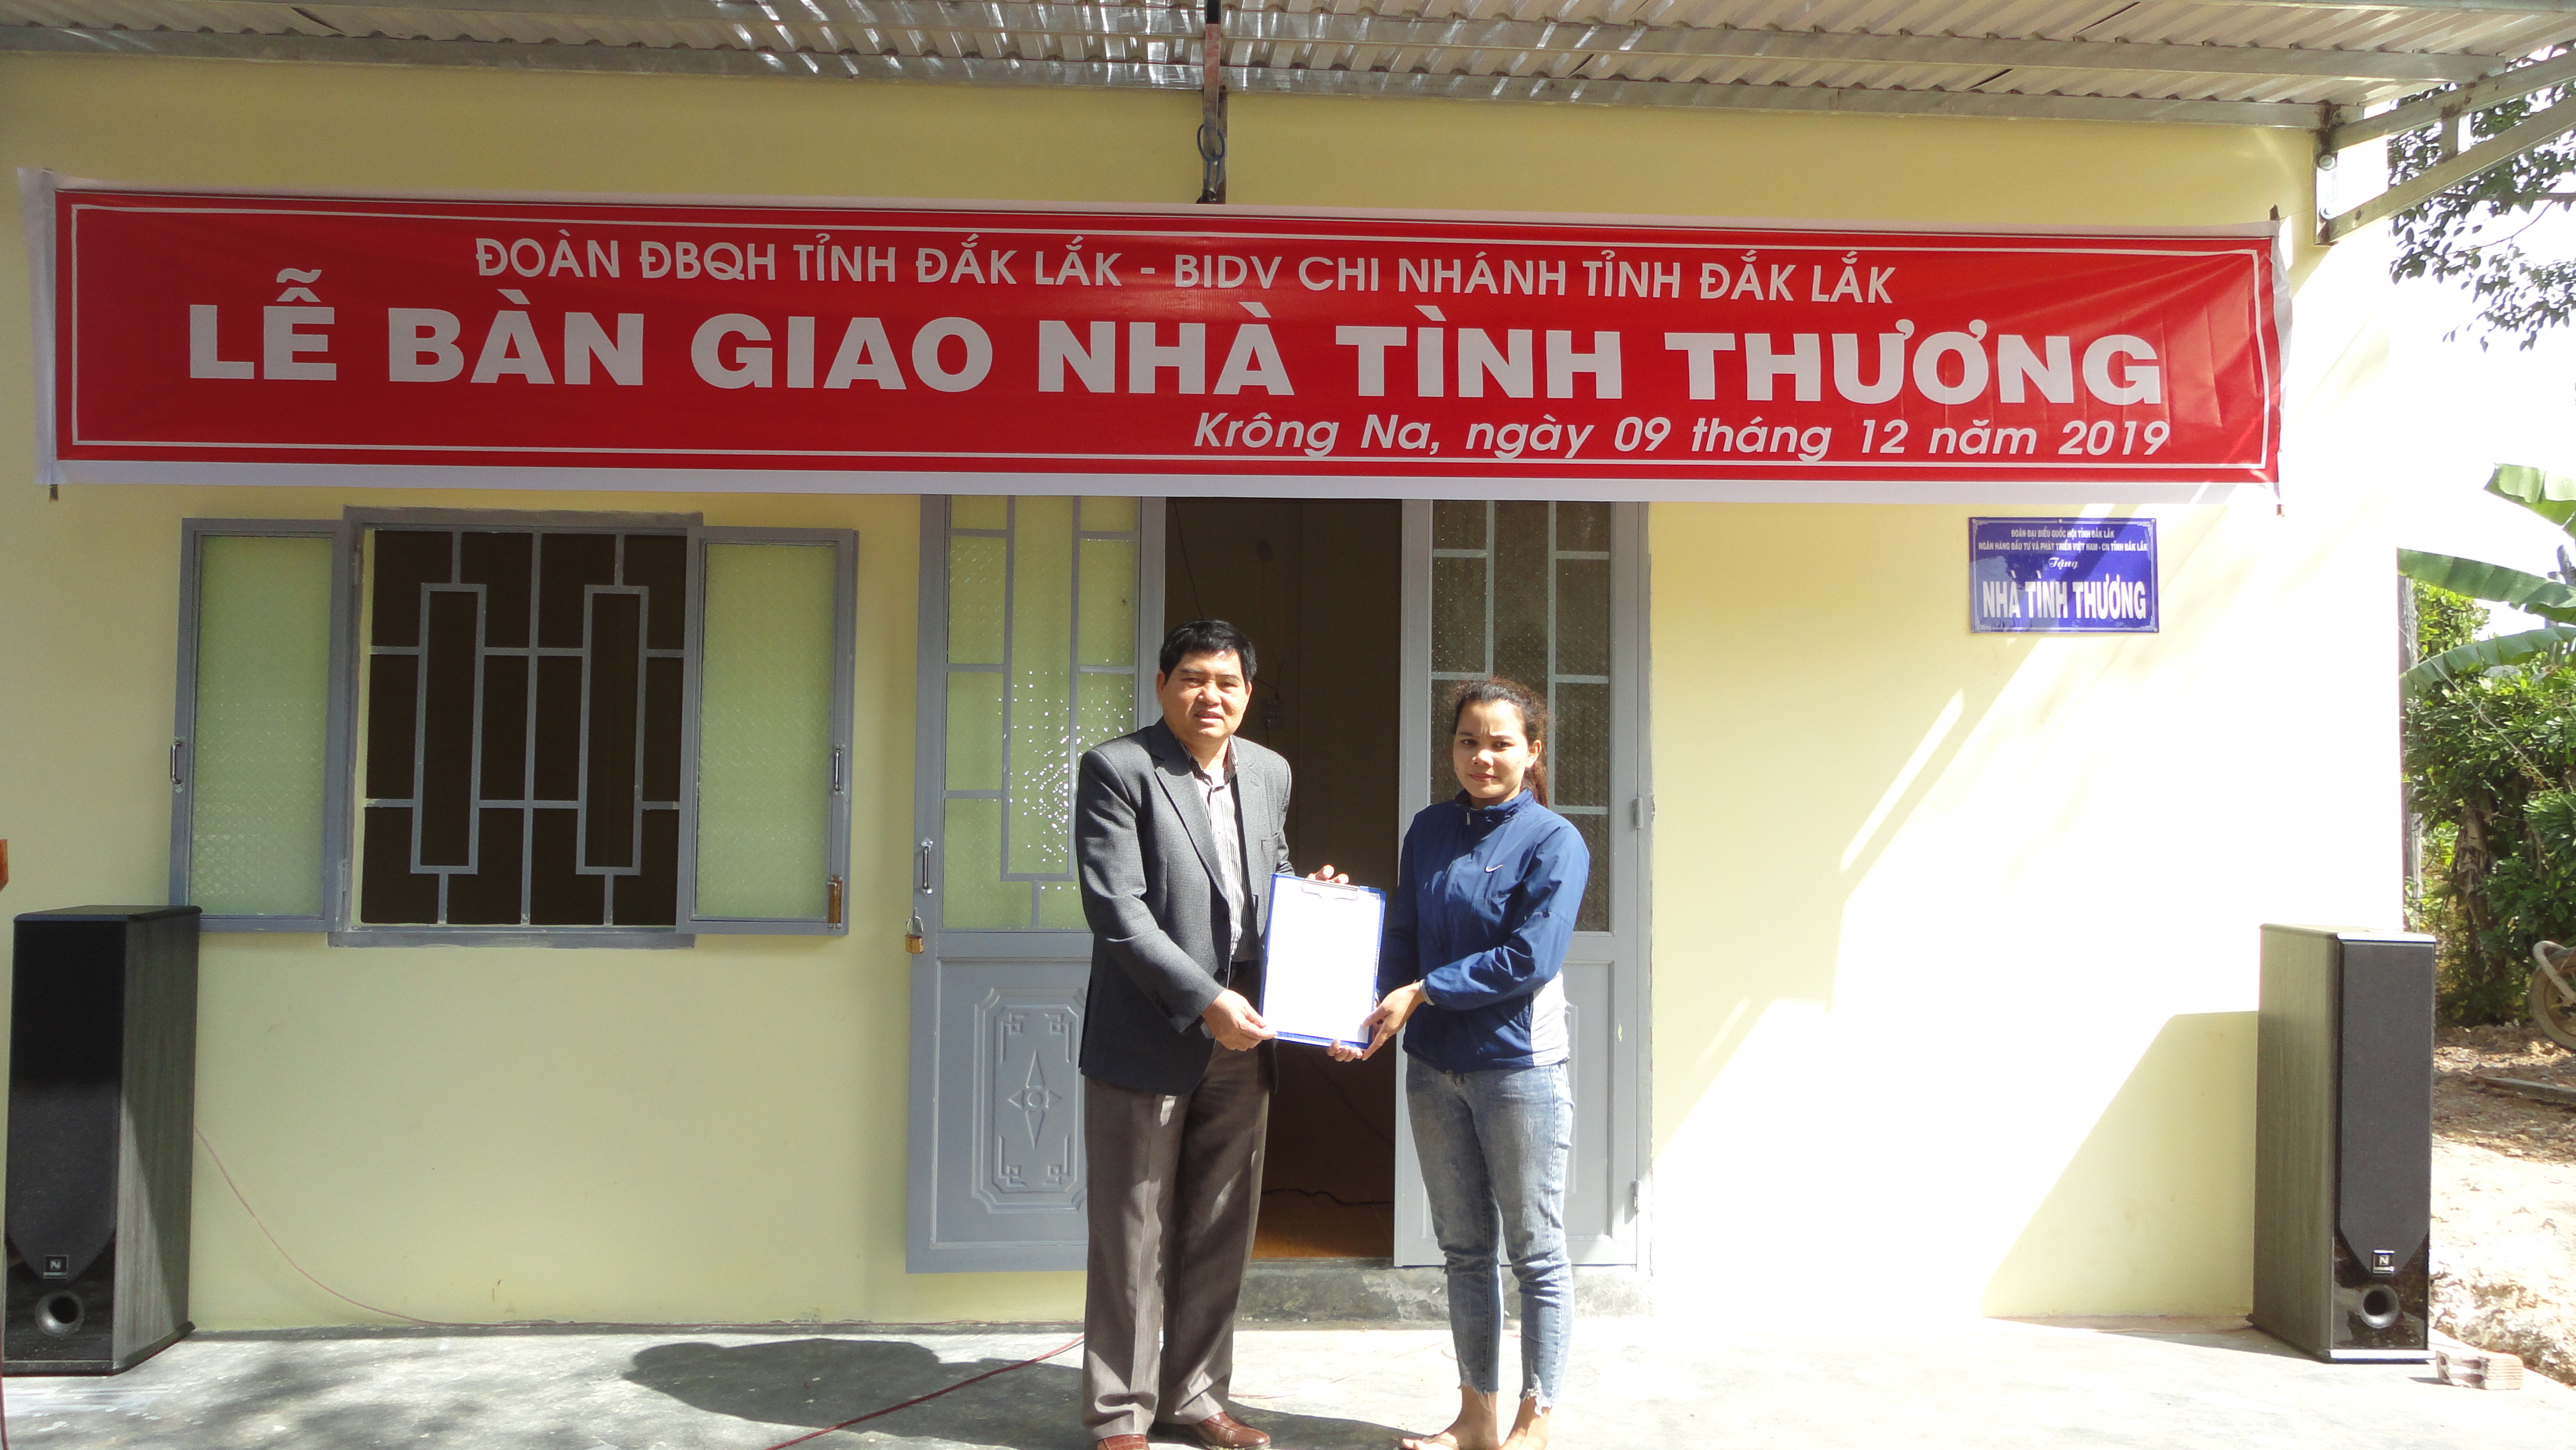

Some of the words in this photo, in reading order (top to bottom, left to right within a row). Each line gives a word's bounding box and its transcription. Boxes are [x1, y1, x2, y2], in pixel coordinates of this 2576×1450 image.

[476, 230, 620, 278] ĐOÀN
[640, 241, 775, 280] ĐBQH
[794, 232, 896, 282] TỈNH
[917, 234, 1017, 284] ĐẮK
[1036, 235, 1122, 286] LẮK
[1175, 255, 1282, 289] BIDV
[1299, 257, 1379, 292] CHI
[1399, 251, 1566, 296] NHÁNH
[1583, 249, 1680, 298] TỈNH
[1699, 250, 1796, 301] ĐẮK
[1812, 250, 1896, 303] LẮK
[190, 268, 337, 381] LỄ
[388, 289, 644, 386] BÀN
[692, 314, 993, 392] GIAO
[1038, 301, 1295, 395] NHÀ
[1336, 305, 1622, 399] TÌNH
[1665, 319, 2162, 406] THƯƠNG
[1194, 411, 1338, 457] Krông
[1361, 414, 1439, 455] Na,
[1466, 413, 1594, 459] ngày
[1614, 416, 1671, 452] 09
[1692, 417, 1832, 462] tháng
[1862, 419, 1909, 454] 12
[1928, 418, 2037, 455] năm
[2058, 420, 2170, 456] 2019
[1983, 571, 2021, 618] NHÀ
[2024, 570, 2069, 618] TÌNH
[2072, 574, 2147, 619] THƯƠNG
